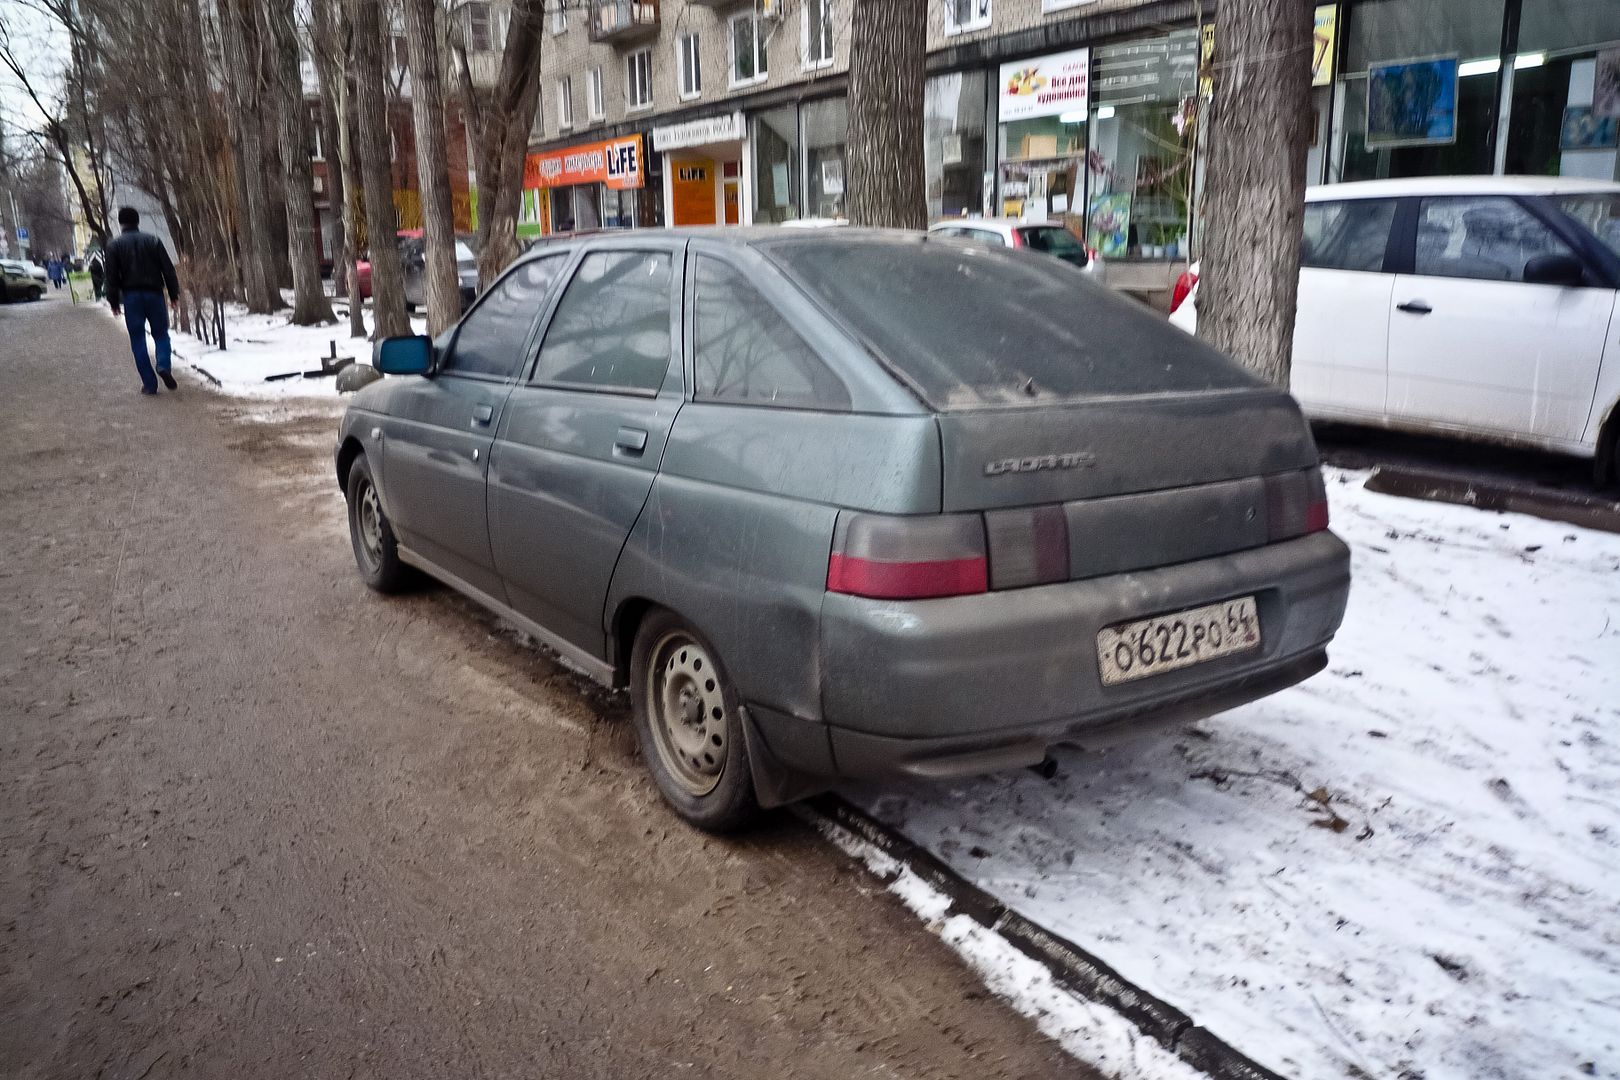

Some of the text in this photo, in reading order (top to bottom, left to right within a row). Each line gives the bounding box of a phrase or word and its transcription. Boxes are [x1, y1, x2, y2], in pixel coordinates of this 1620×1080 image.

[1051, 74, 1086, 89] Все для
[1037, 88, 1086, 105] художника
